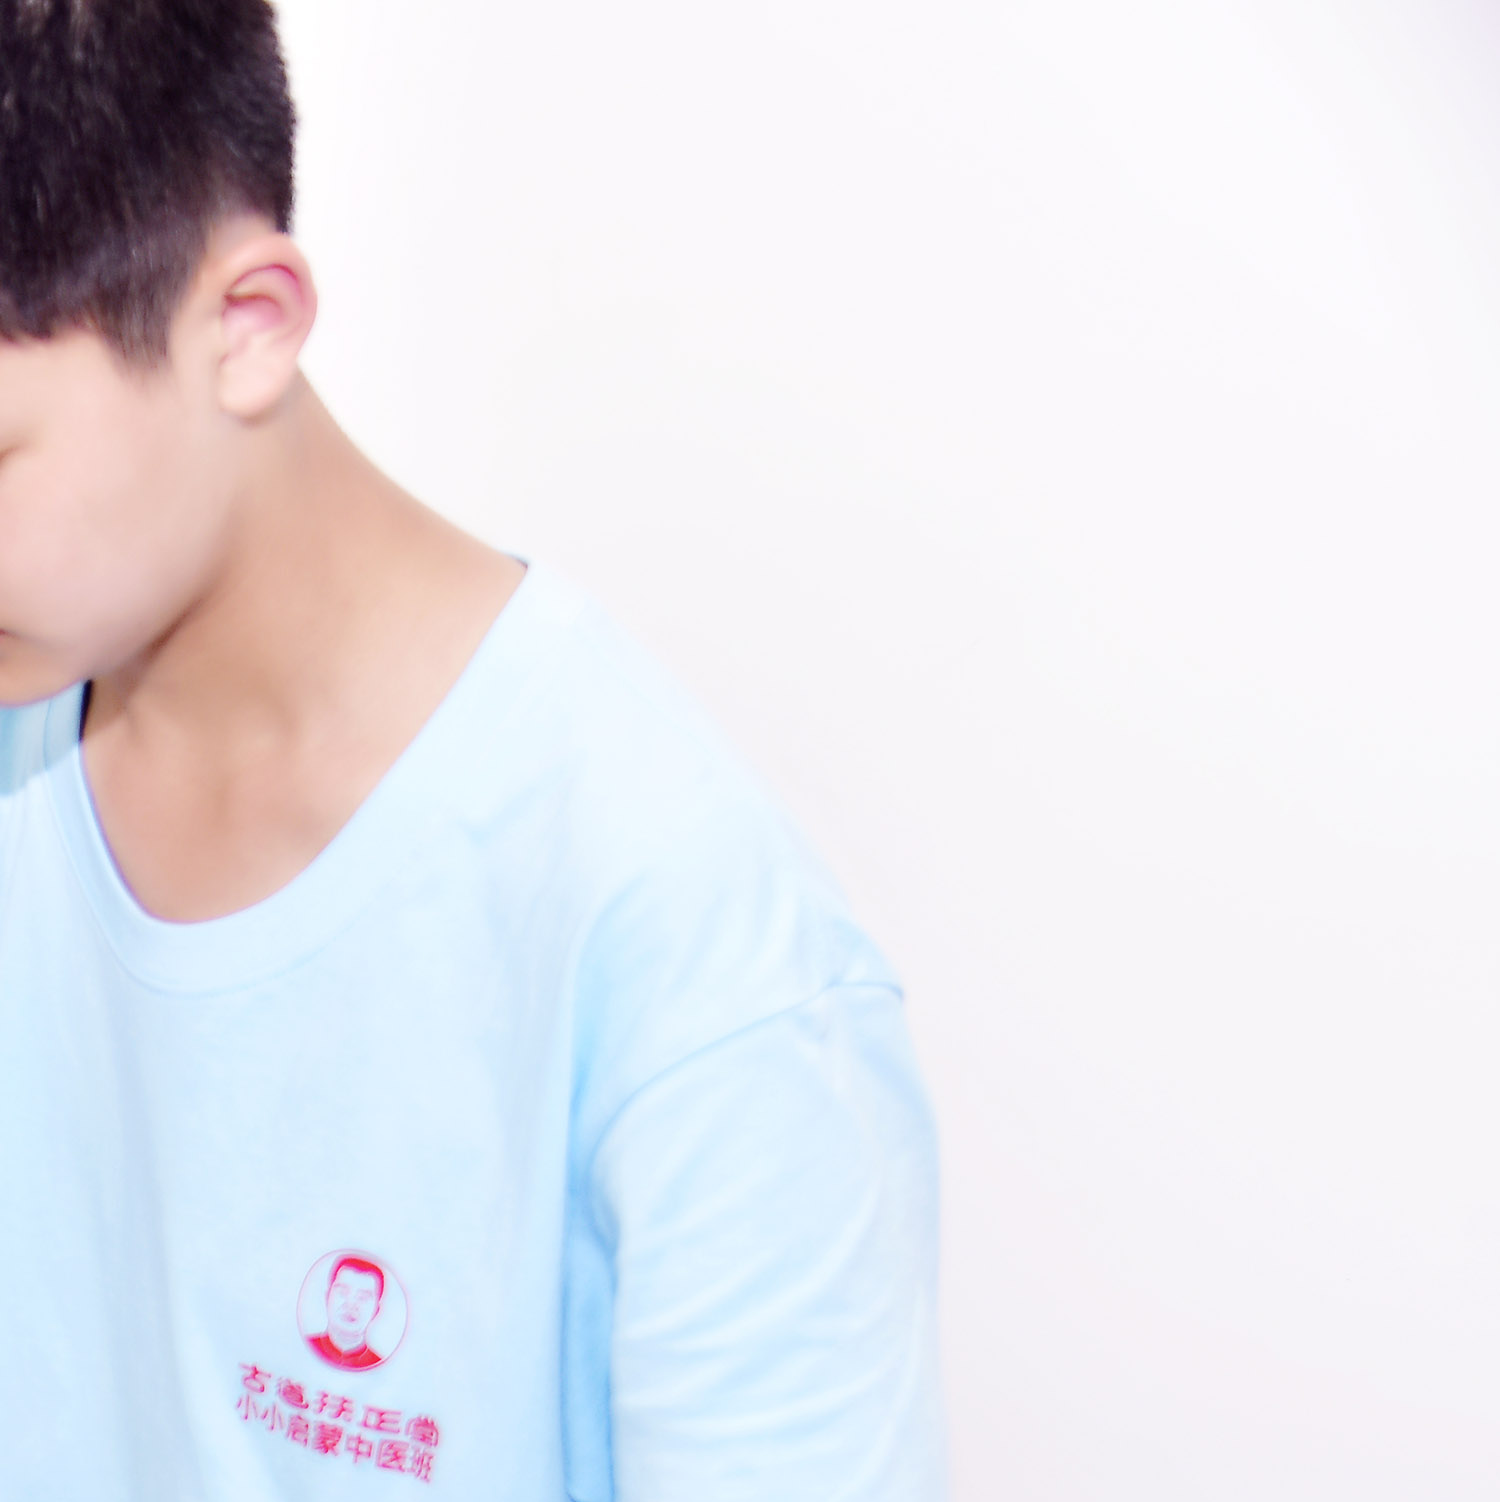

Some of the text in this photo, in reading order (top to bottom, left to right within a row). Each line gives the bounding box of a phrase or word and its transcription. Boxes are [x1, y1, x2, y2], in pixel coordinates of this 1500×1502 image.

[236, 1395, 434, 1482] 小小启蒙中医班
